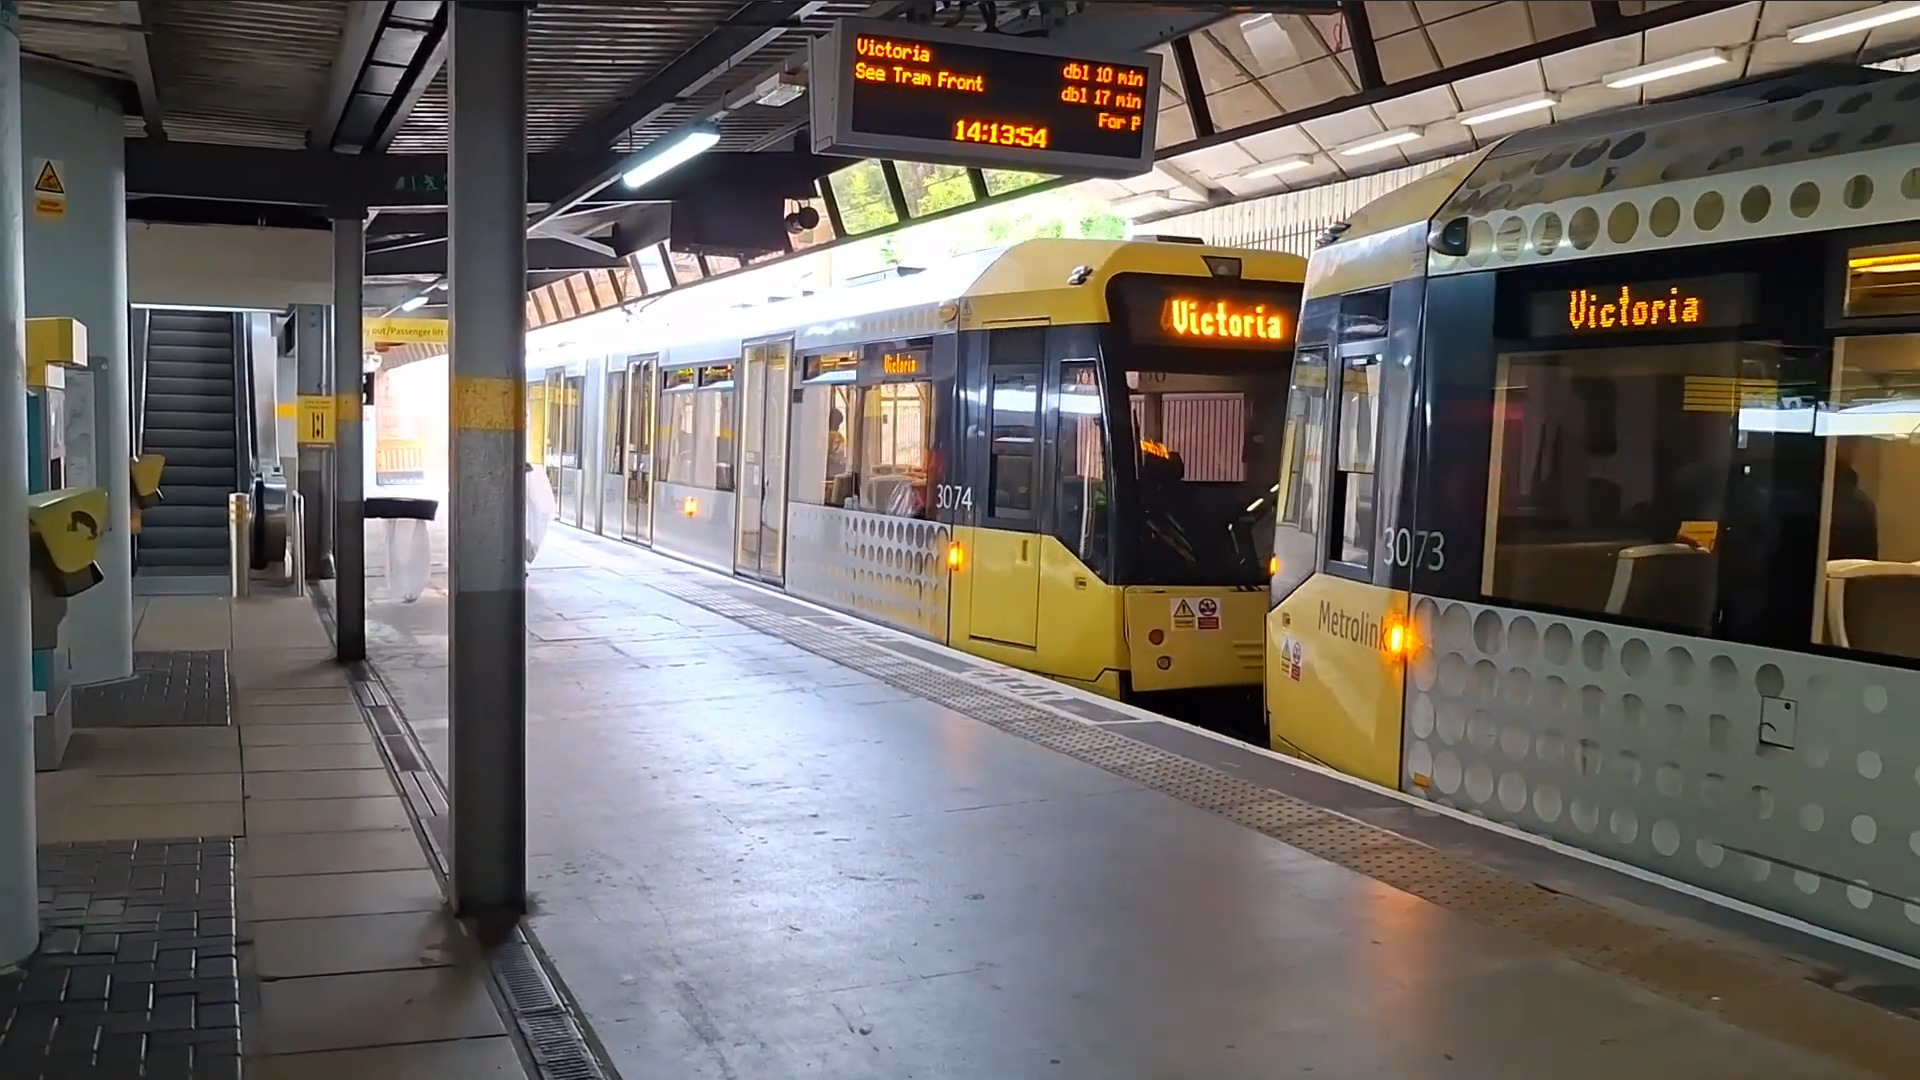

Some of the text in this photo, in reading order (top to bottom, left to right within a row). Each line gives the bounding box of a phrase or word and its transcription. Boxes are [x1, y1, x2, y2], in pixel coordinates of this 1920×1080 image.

[856, 37, 931, 63] Victoria
[855, 62, 984, 92] See Tram Front
[1063, 63, 1144, 87] dbl 10 min
[1061, 86, 1142, 110] dbl 17 min
[955, 120, 1047, 148] 14:13:54
[1098, 112, 1127, 130] For
[1171, 299, 1283, 340] Victoria
[1569, 286, 1699, 330] Victoria
[884, 354, 918, 375] Victoria
[936, 484, 973, 512] 3074
[1383, 526, 1446, 572] 3073
[1318, 599, 1389, 652] Metrolink
